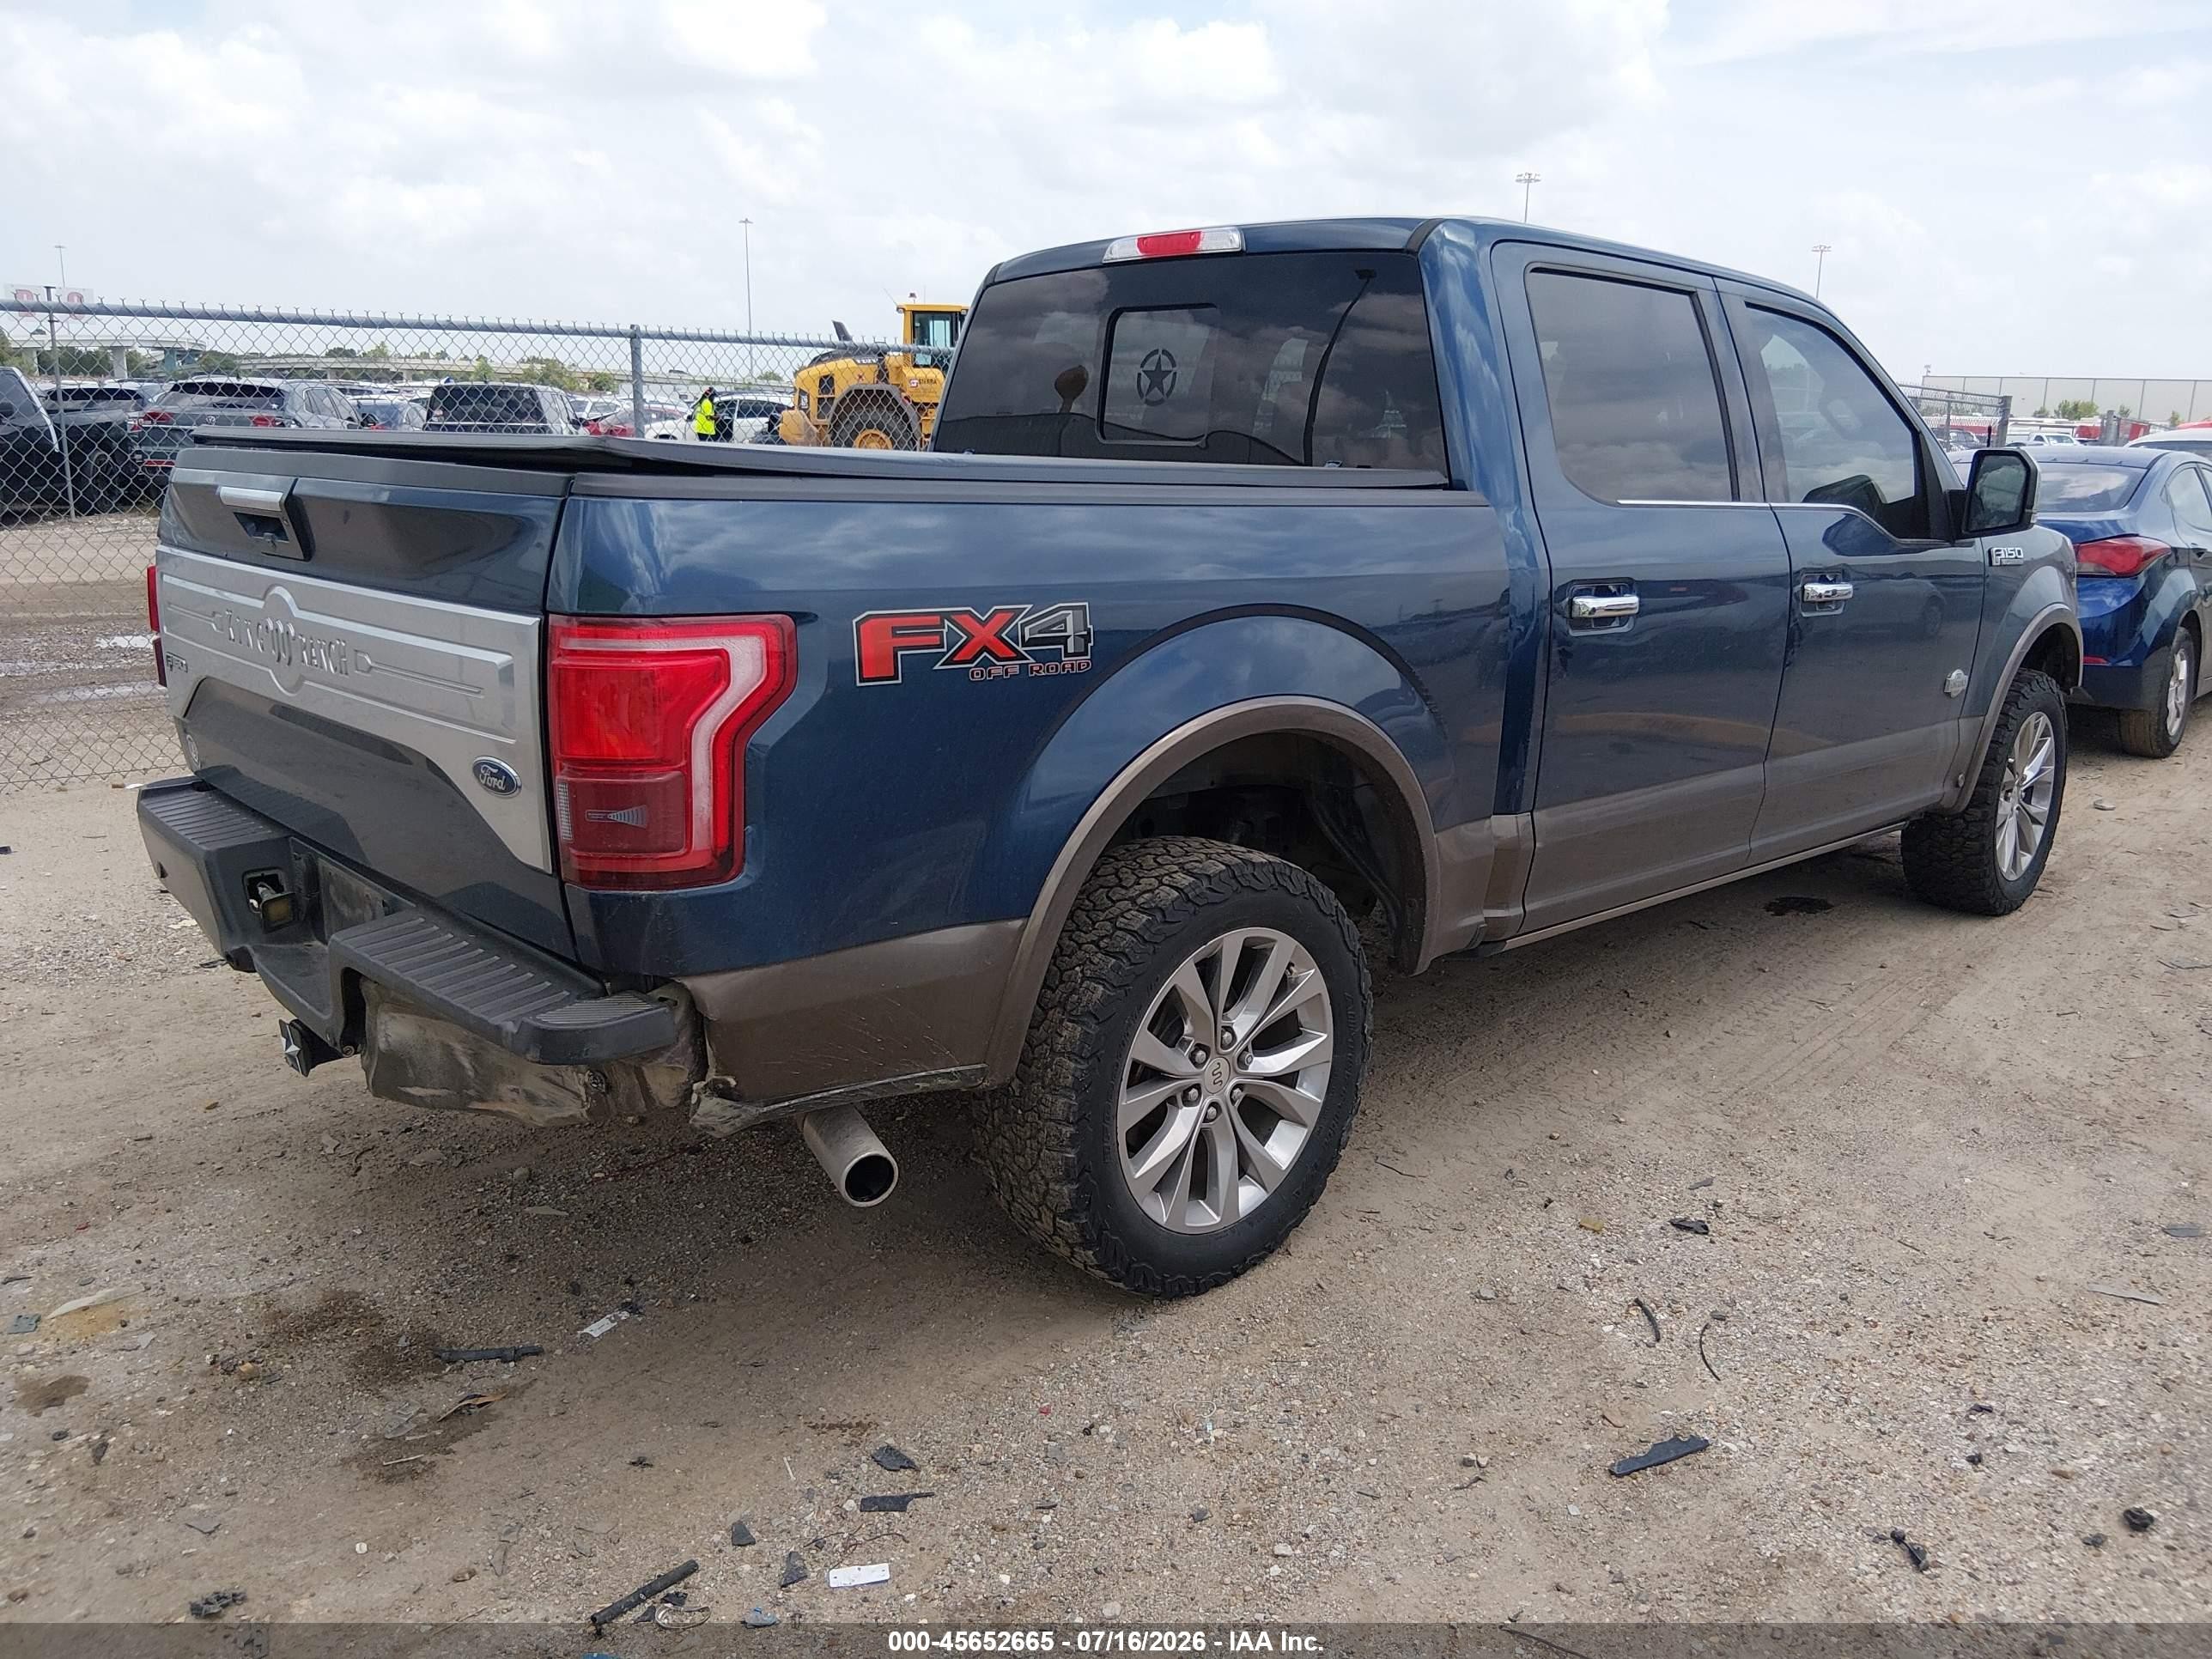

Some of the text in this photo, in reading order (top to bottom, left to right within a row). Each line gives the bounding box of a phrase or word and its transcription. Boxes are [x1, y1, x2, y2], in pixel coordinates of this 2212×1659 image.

[854, 602, 1093, 686] FX4
[969, 659, 1092, 682] OFF ROAD
[479, 764, 507, 791] Ford
